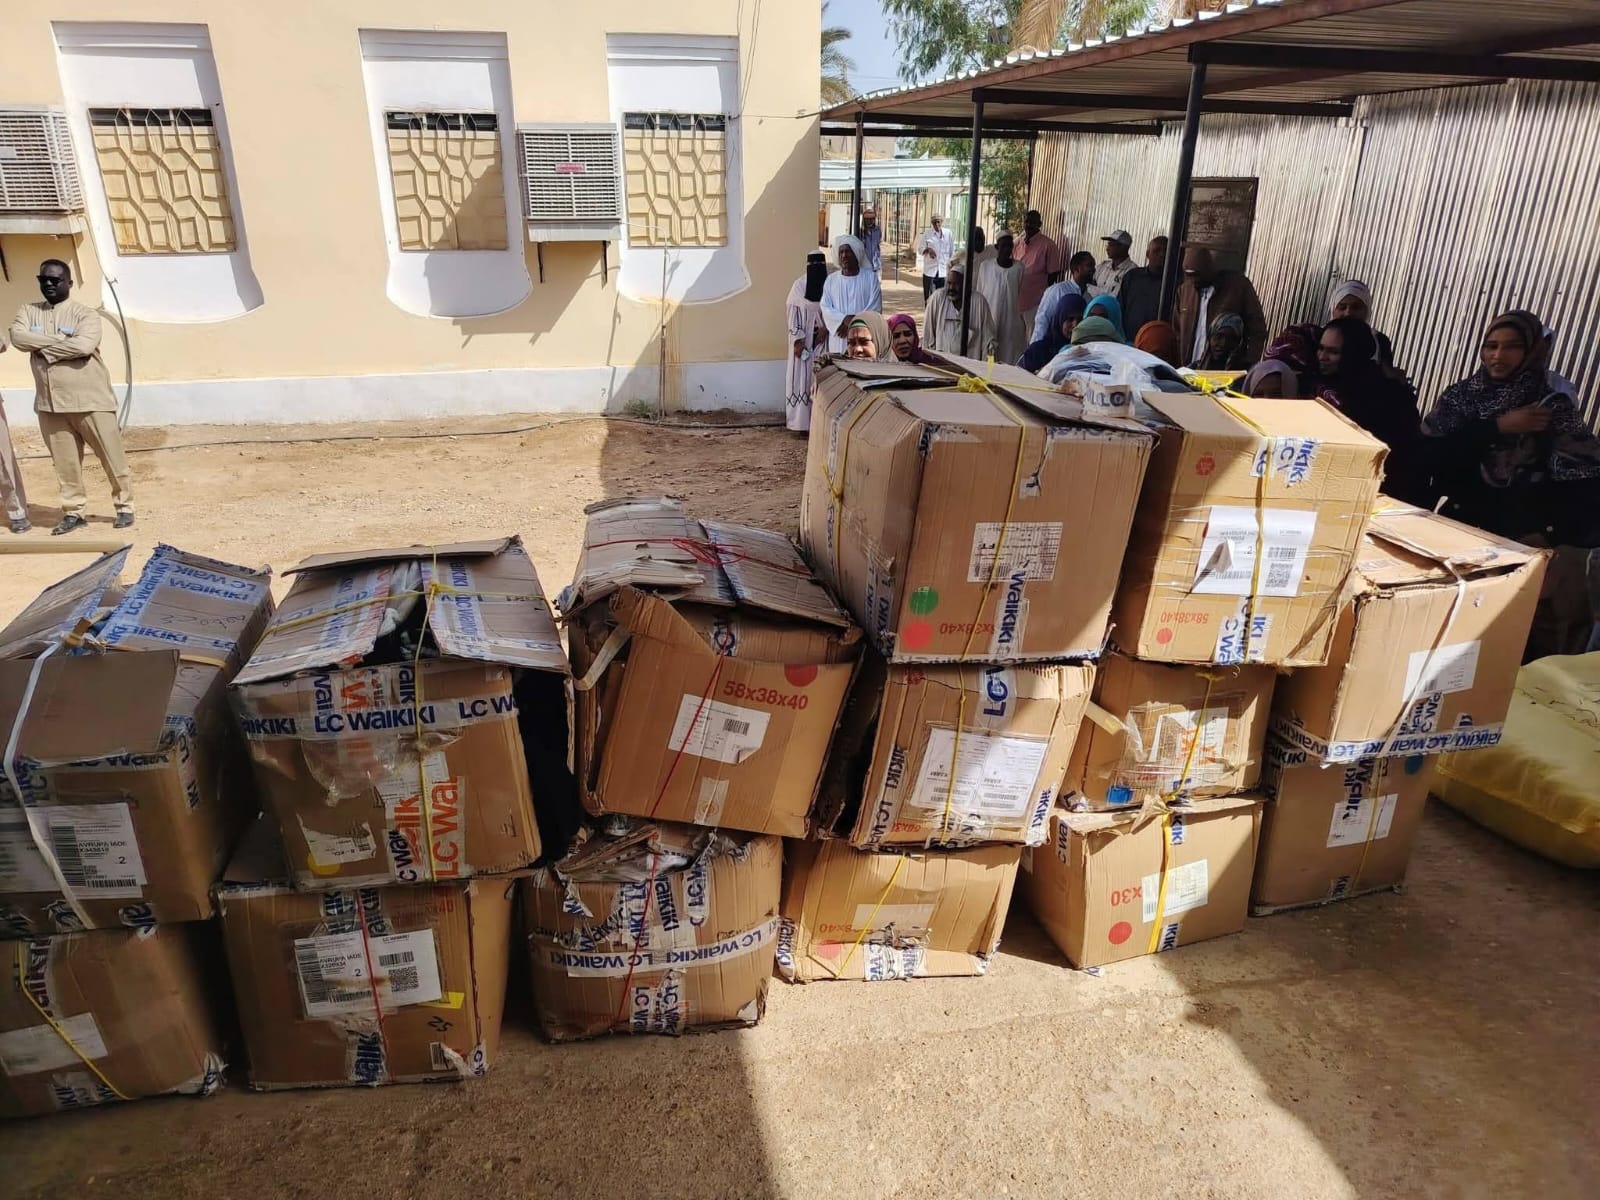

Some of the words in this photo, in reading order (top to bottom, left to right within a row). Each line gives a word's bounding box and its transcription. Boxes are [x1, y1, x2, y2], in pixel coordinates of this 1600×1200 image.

[722, 680, 809, 711] 58x38x40
[314, 714, 345, 734] LC
[458, 698, 489, 720] LC
[117, 856, 127, 865] 2
[353, 968, 363, 977] 2
